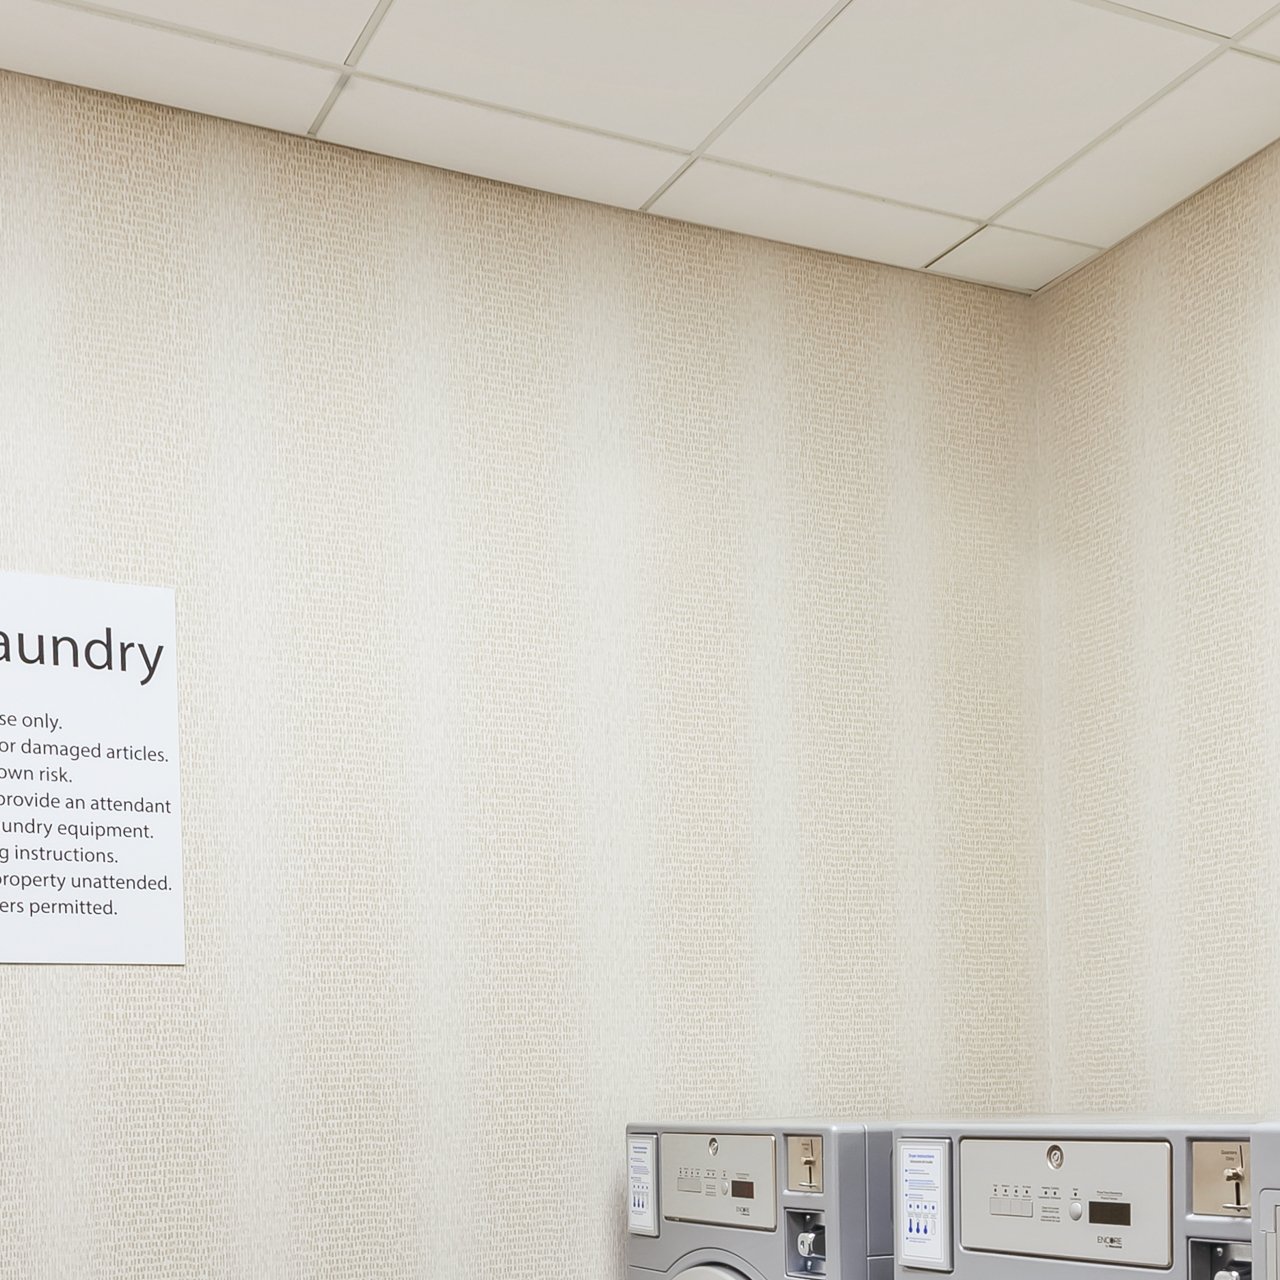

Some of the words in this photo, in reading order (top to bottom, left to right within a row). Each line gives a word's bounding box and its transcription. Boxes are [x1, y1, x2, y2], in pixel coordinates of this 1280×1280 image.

[21, 712, 63, 734] only.
[20, 737, 102, 762] damaged
[105, 744, 169, 763] articles.
[39, 766, 73, 784] risk.
[64, 797, 86, 810] an
[89, 796, 172, 815] attendant
[57, 820, 154, 841] equipment.
[14, 844, 119, 864] instructions.
[70, 874, 173, 892] unattended.
[29, 898, 118, 918] permitted.
